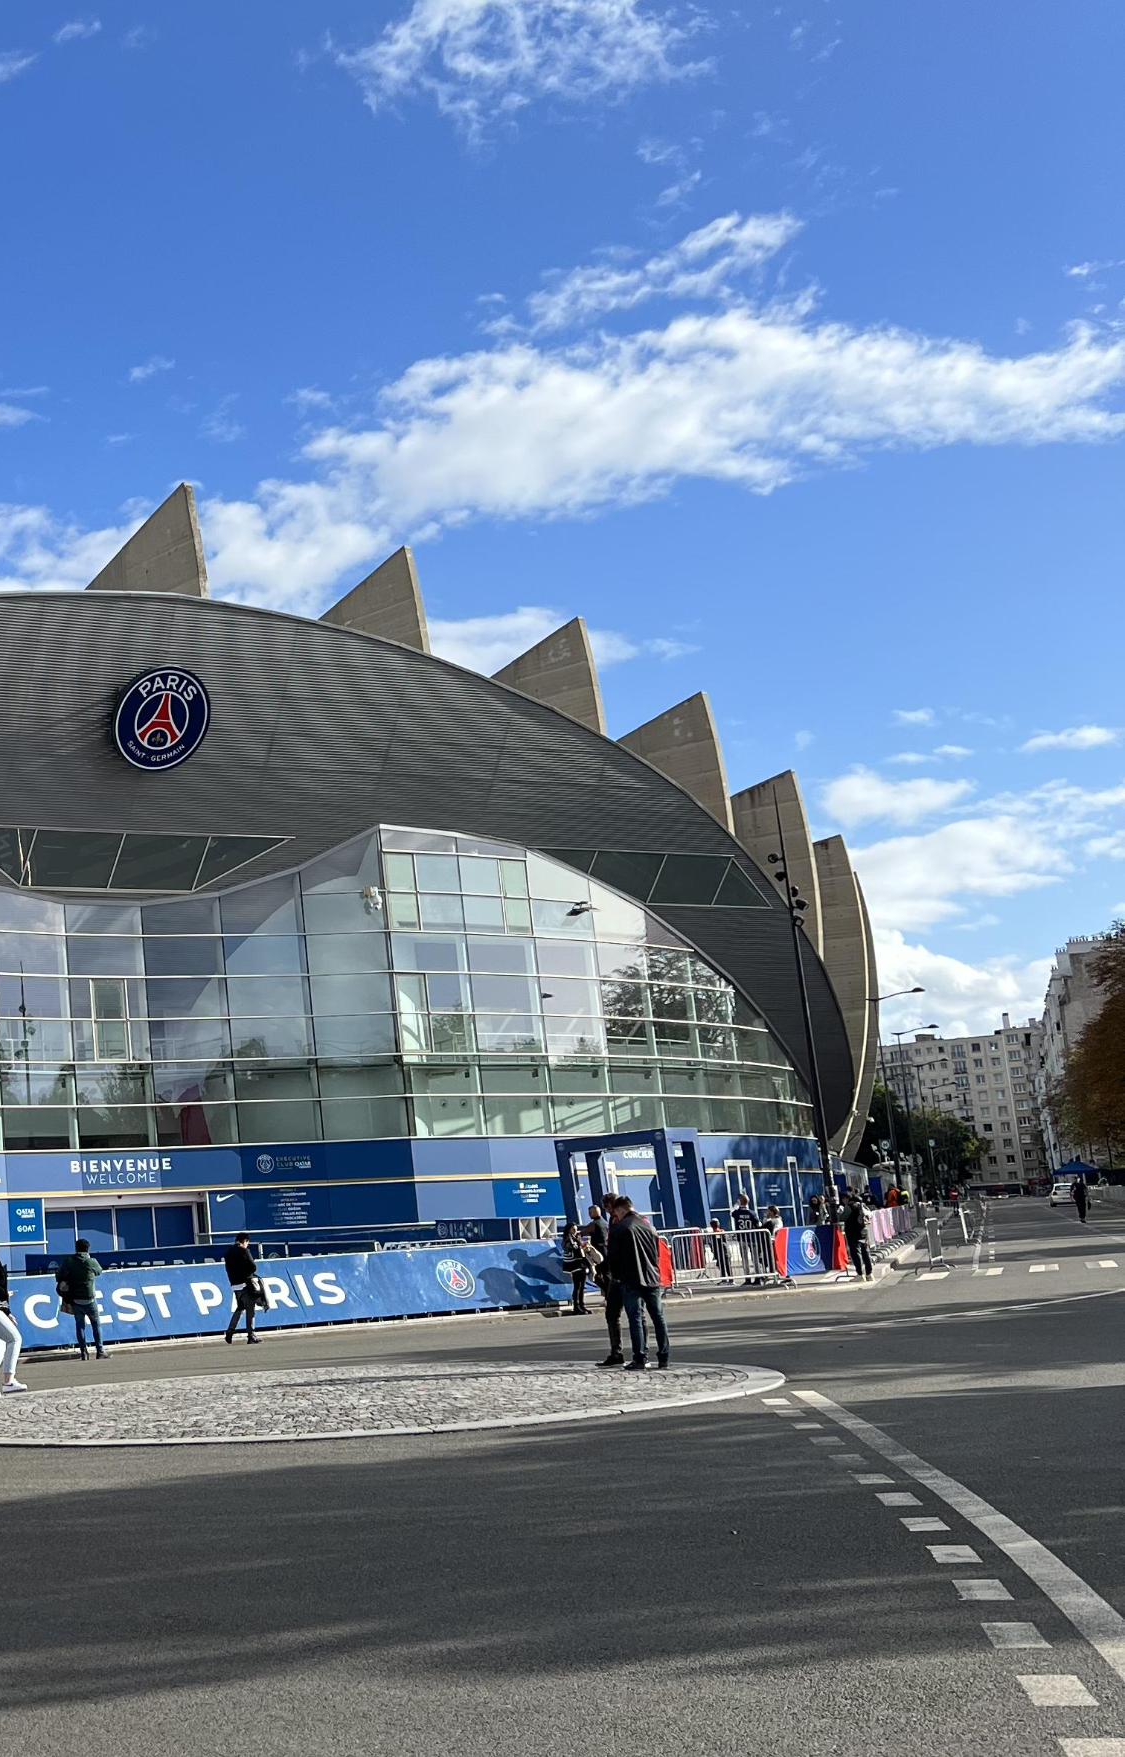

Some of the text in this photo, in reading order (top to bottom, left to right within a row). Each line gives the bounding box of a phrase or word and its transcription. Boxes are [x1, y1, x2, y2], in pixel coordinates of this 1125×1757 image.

[138, 675, 198, 701] PARIS
[623, 1149, 655, 1159] CONCIER
[70, 1157, 172, 1173] BIENVENUE
[86, 1172, 157, 1185] WELCOME
[17, 1225, 36, 1233] GOAT
[738, 1219, 752, 1230] 30
[24, 1284, 172, 1329] CEST
[189, 1272, 346, 1315] PRIS
